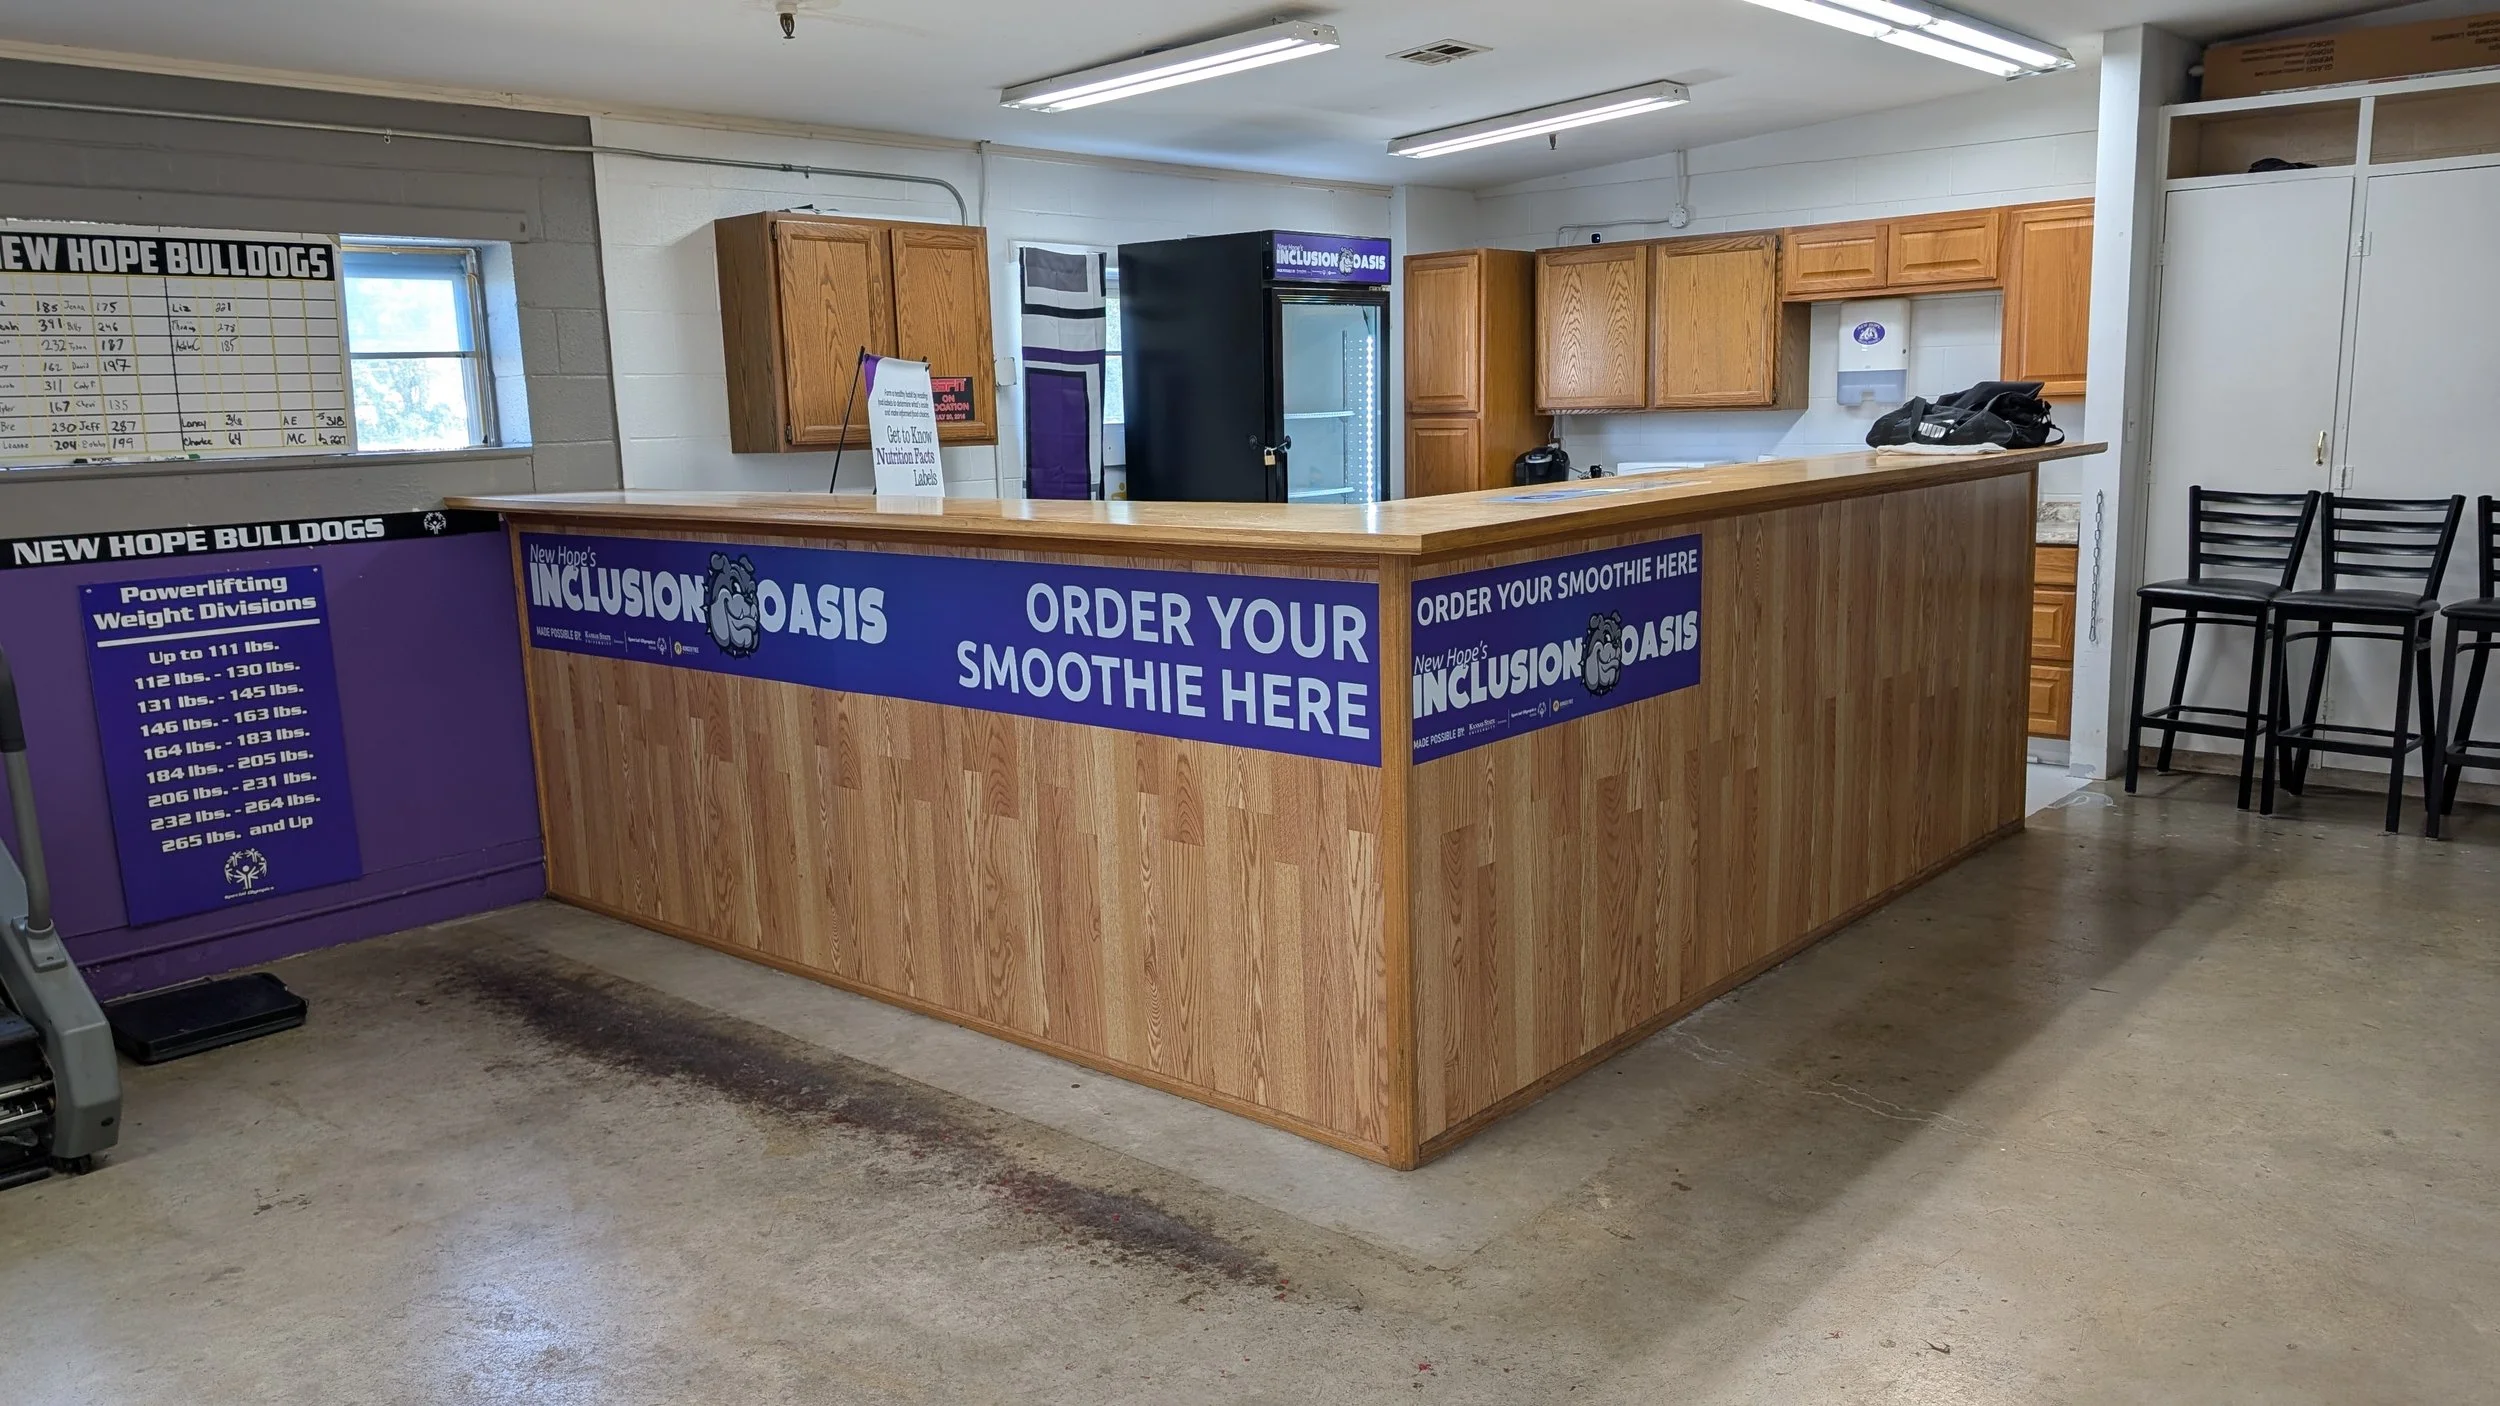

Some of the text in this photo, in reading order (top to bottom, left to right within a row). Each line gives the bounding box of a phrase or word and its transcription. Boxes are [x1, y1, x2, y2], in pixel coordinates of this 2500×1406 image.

[0, 235, 328, 277] EW HOPE BULLDOGS
[1276, 249, 1386, 270] INCLUSION OASIS
[36, 301, 58, 313] 185
[96, 301, 118, 314] 175
[41, 339, 67, 351] 232
[103, 359, 131, 372] 197
[934, 402, 969, 411] OCATION
[942, 394, 955, 403] ON
[887, 425, 932, 443] Get to Know
[876, 447, 935, 465] Nutrition Facts
[913, 468, 938, 486] Labels
[13, 518, 385, 565] NEW HOPE BULLDOGS
[530, 544, 596, 572] New Hope's
[120, 576, 288, 603] Powerlifting
[530, 563, 888, 644] INCLUSION OASIS
[1417, 549, 1698, 626] ORDER YOUR SMOOTHIE HERE
[93, 595, 316, 632] Weight Divisions
[1026, 582, 1370, 663] ORDER YOUR
[149, 640, 280, 665] Up to 111 lbs.
[1412, 611, 1698, 719] INCLUSION OASIS
[1414, 640, 1488, 675] New Hope's
[134, 674, 171, 690] 112
[174, 672, 211, 685] lbs.
[226, 663, 263, 679] 130
[266, 660, 300, 674] lbs.
[957, 640, 1370, 740] SMOOTHIE HERE
[137, 698, 171, 714] 131
[178, 695, 215, 708] lbs.
[230, 686, 266, 701] 145
[270, 682, 304, 696] lbs.
[140, 720, 179, 737] 146
[183, 718, 219, 731] lbs.
[234, 708, 269, 723] 163
[273, 705, 307, 718] lbs.
[144, 743, 183, 760] 164
[186, 740, 222, 754] lbs.
[237, 730, 272, 746] 183
[276, 727, 310, 741] lbs.
[1413, 736, 1429, 750] MADE
[1430, 729, 1456, 745] POSSIBLE
[146, 767, 185, 784] 184
[188, 764, 224, 777] lbs.
[238, 752, 276, 769] 205
[280, 749, 314, 763] lbs.
[148, 789, 189, 808] 206
[193, 786, 229, 800] lbs.
[242, 775, 277, 792] 231
[283, 771, 317, 785] lbs.
[151, 813, 192, 831] 232
[195, 809, 231, 823] lbs.
[245, 796, 284, 814] 264
[287, 793, 321, 807] lbs.
[162, 815, 313, 853] 265 lbs. and Up
